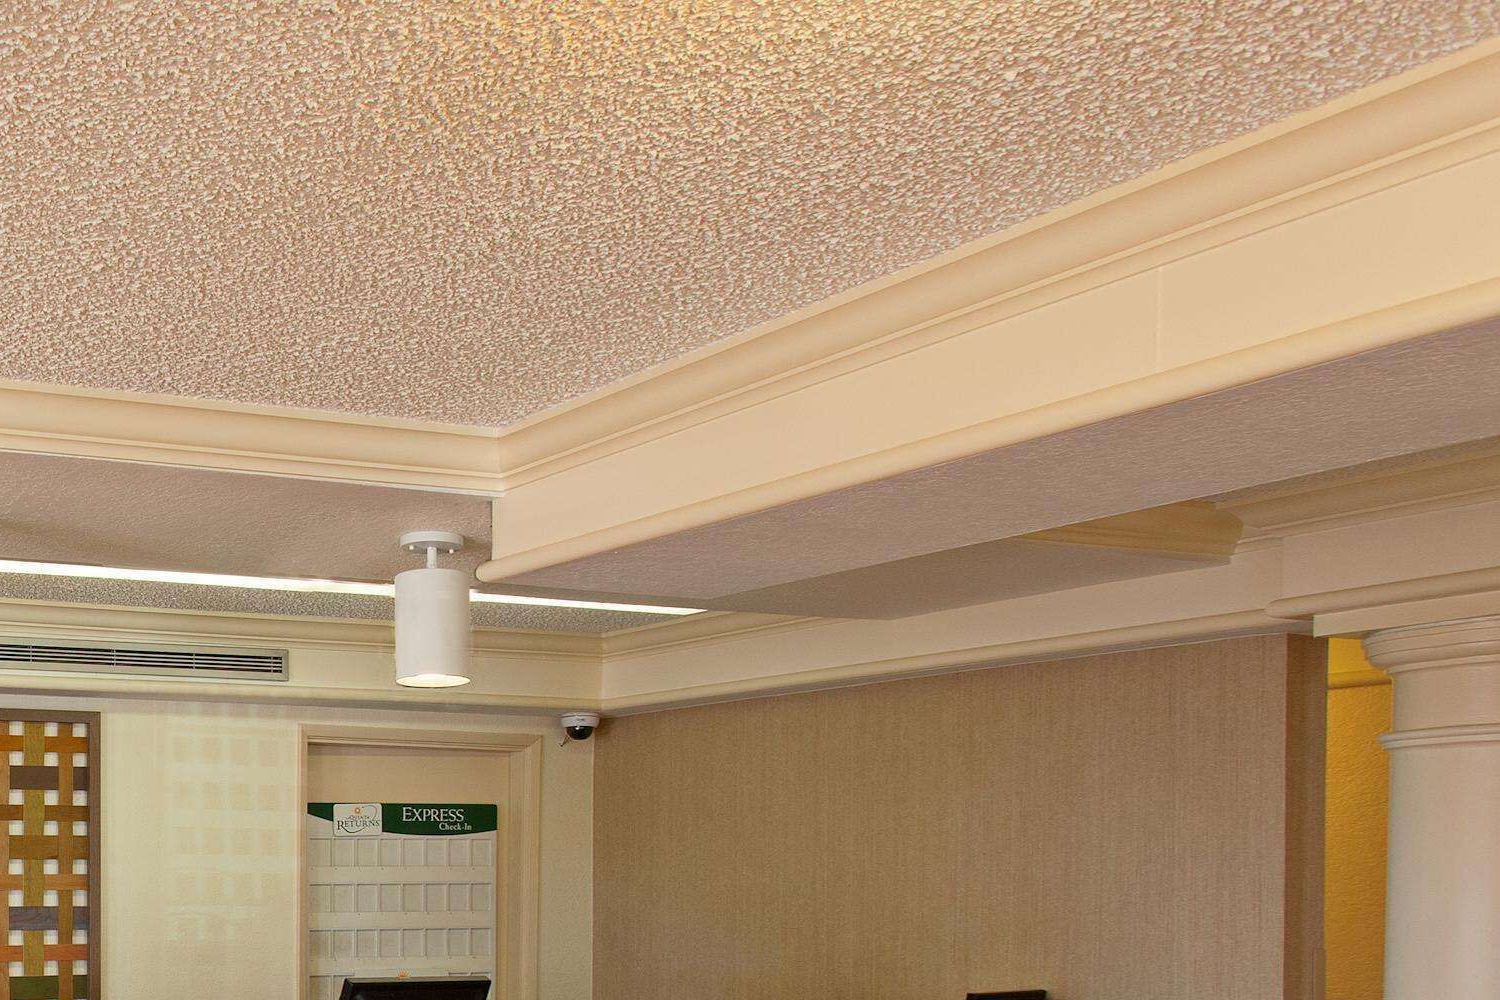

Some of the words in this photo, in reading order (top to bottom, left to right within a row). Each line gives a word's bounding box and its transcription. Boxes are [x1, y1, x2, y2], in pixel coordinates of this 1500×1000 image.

[402, 806, 465, 822] EXPRESS
[337, 820, 380, 830] RETURNS
[438, 822, 473, 831] Check-In
